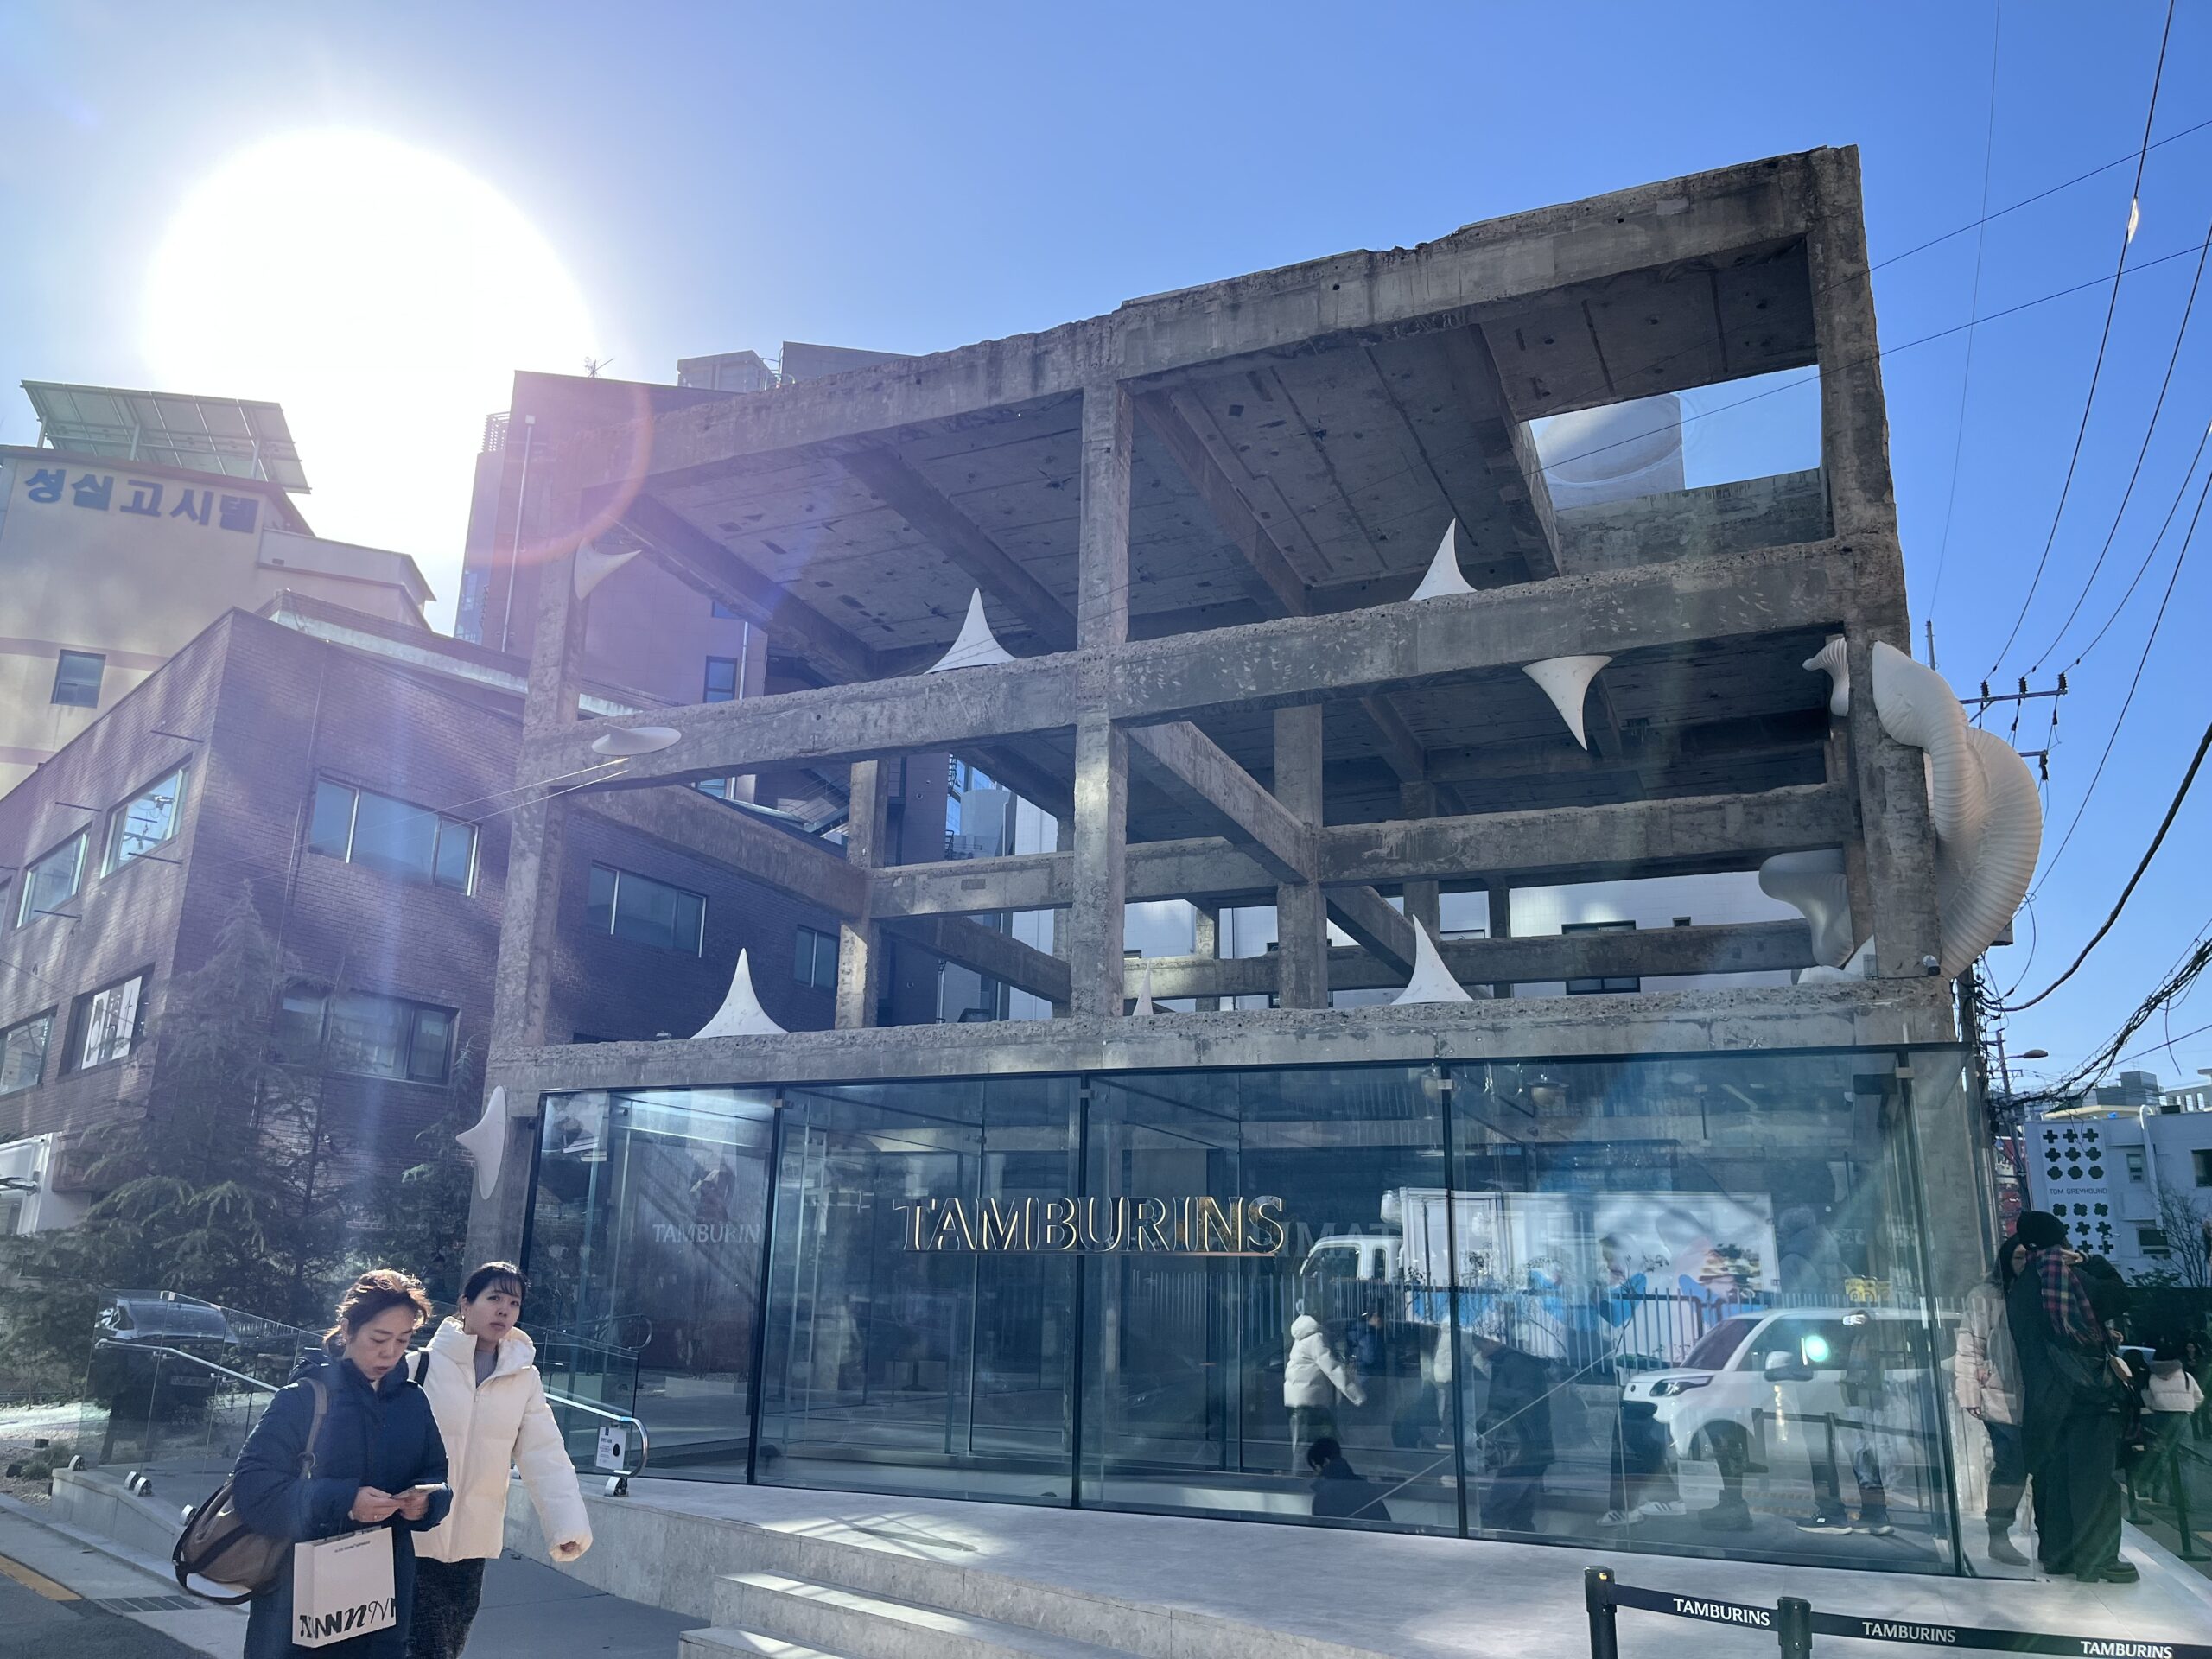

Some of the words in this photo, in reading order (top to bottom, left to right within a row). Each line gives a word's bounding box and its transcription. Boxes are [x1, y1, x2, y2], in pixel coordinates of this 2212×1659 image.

[24, 468, 259, 534] 성실고시텔
[652, 1223, 760, 1243] TAMBURIN
[893, 1195, 1285, 1253] TAMBURINS
[1673, 1598, 1770, 1626] TAMBURINS
[1862, 1621, 1956, 1643] TAMBURINS
[2081, 1640, 2173, 1659] TAMBURINS
